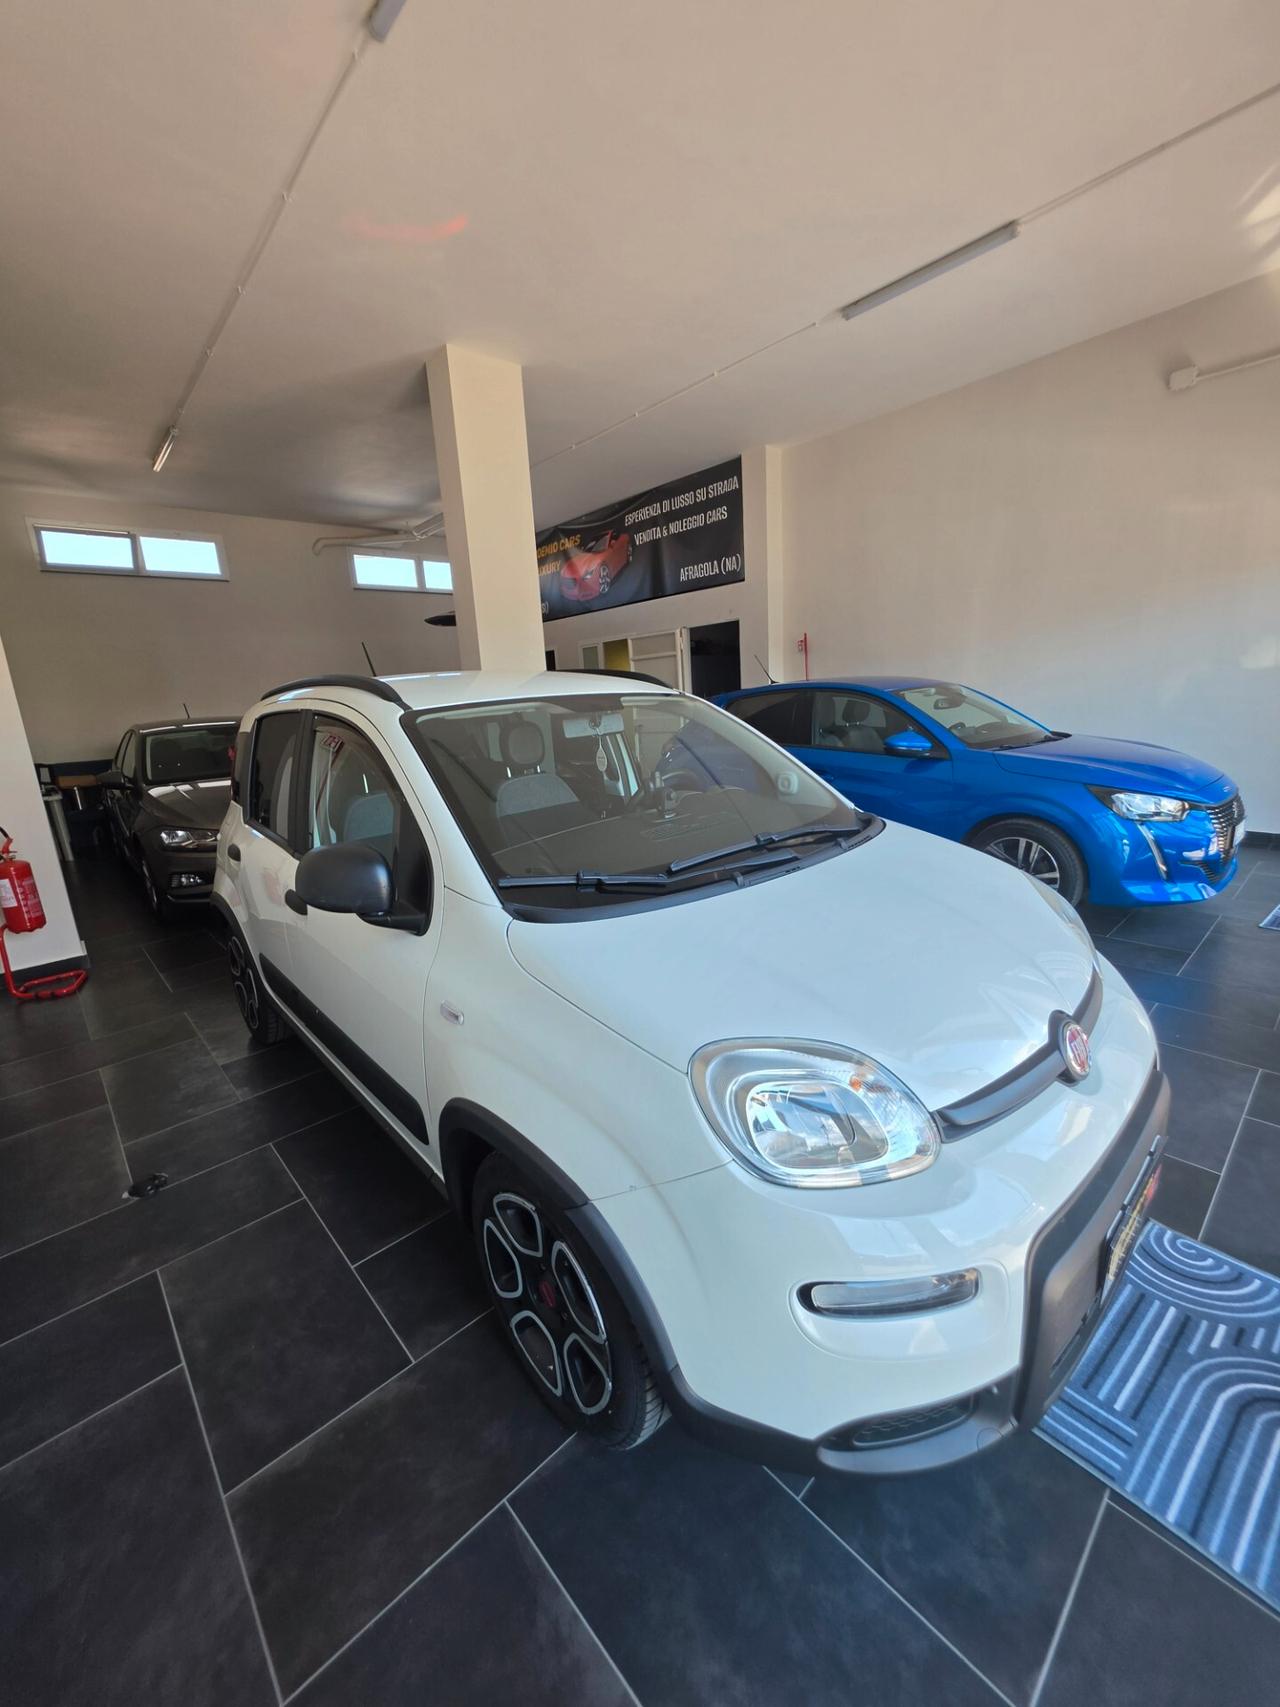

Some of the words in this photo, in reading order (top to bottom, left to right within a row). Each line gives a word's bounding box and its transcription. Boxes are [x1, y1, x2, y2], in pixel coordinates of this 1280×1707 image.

[624, 502, 661, 526] ESPERIENZA
[662, 499, 670, 513] DI
[671, 491, 694, 511] LUSSO
[695, 487, 707, 502] SU
[708, 475, 739, 499] STRADA
[560, 534, 581, 550] CARS
[634, 526, 662, 546] VENDITA
[662, 525, 668, 537] &
[669, 513, 705, 535] NOLEGGIO
[706, 505, 728, 524] CARS
[680, 560, 719, 582] AFRAGOLA
[721, 553, 741, 575] (NA)
